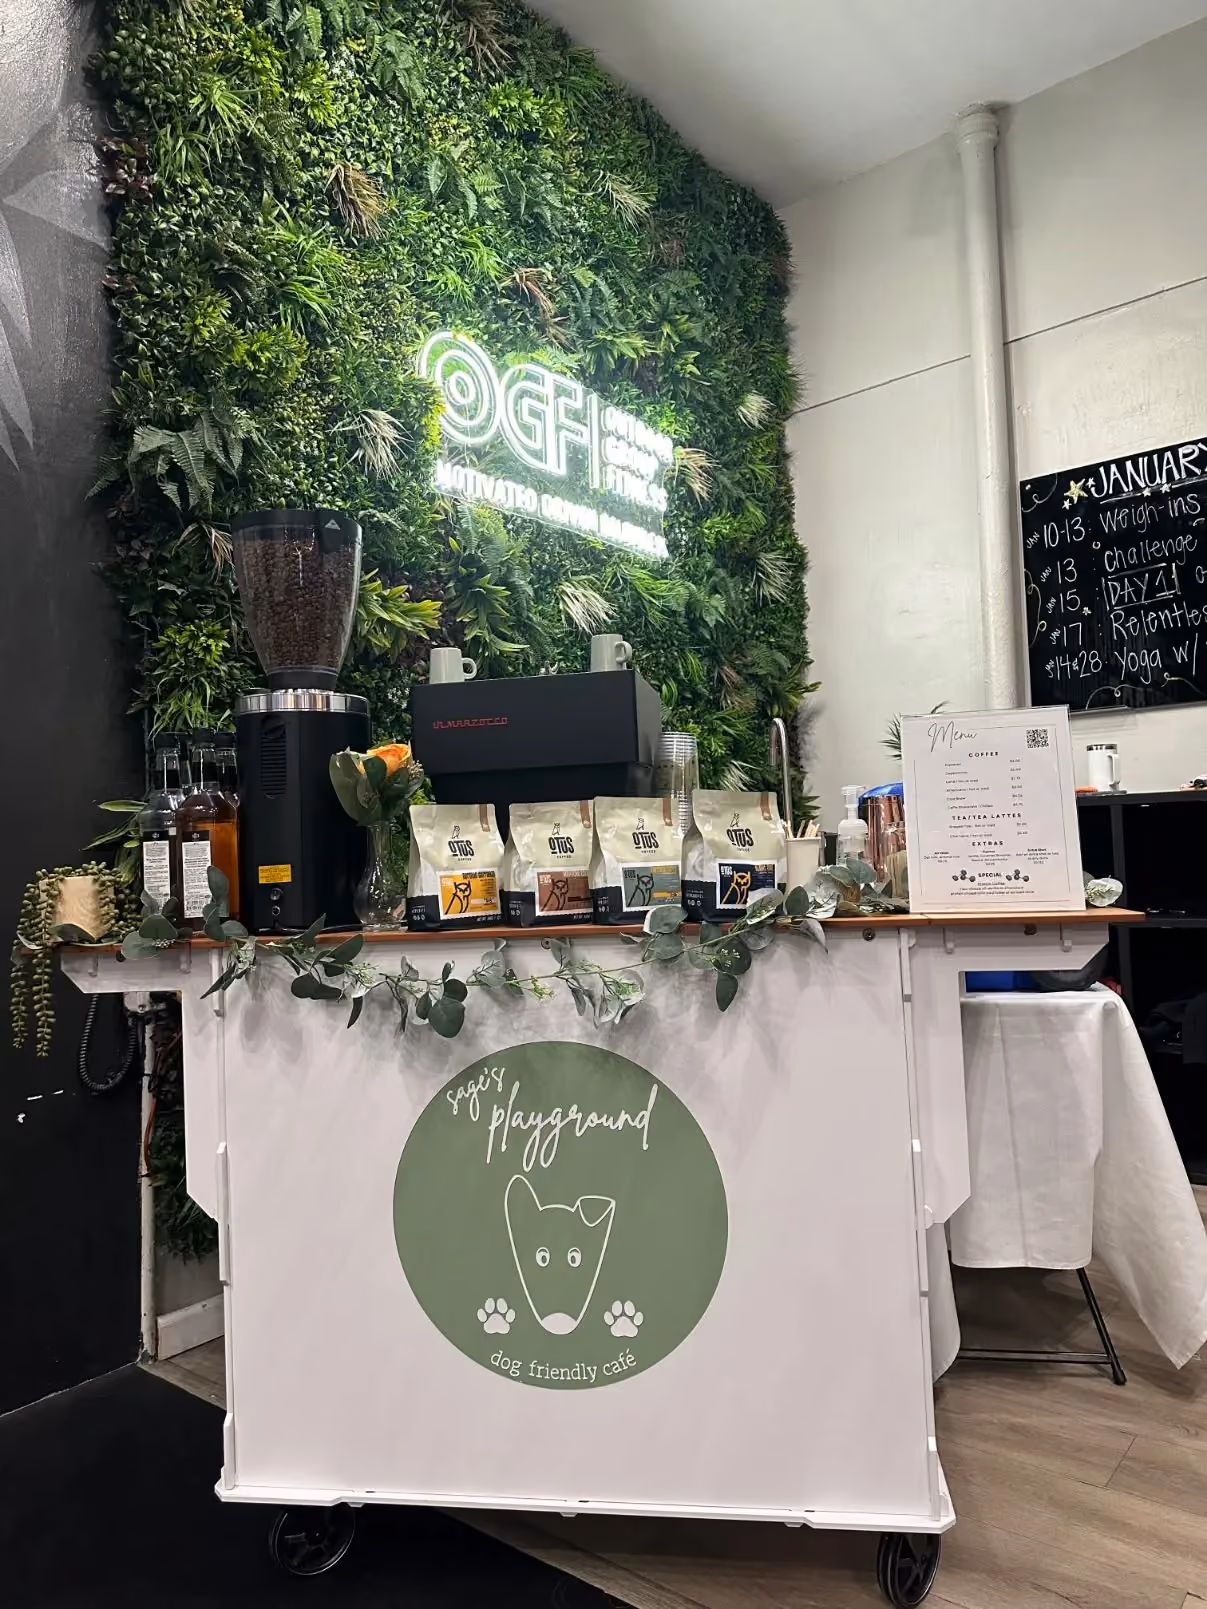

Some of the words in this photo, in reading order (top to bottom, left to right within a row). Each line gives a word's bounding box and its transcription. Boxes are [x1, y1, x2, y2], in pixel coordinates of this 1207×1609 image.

[1026, 531, 1040, 549] JAN
[1040, 566, 1052, 582] JAN
[1057, 557, 1078, 584] 13
[1046, 596, 1057, 613] JAN
[1060, 588, 1081, 613] 15
[1108, 572, 1149, 606] DAY
[1050, 628, 1061, 645] JAN
[1063, 622, 1082, 647] 17
[927, 720, 978, 752] Menu
[447, 839, 475, 858] OTUS
[548, 836, 575, 855] OTUS
[632, 831, 659, 849] OTUS
[726, 828, 754, 848] OTUS
[446, 1066, 506, 1121] sage's
[486, 1080, 658, 1172] playground
[490, 1350, 522, 1376] dog
[528, 1361, 597, 1382] friendly
[602, 1348, 637, 1376] café
